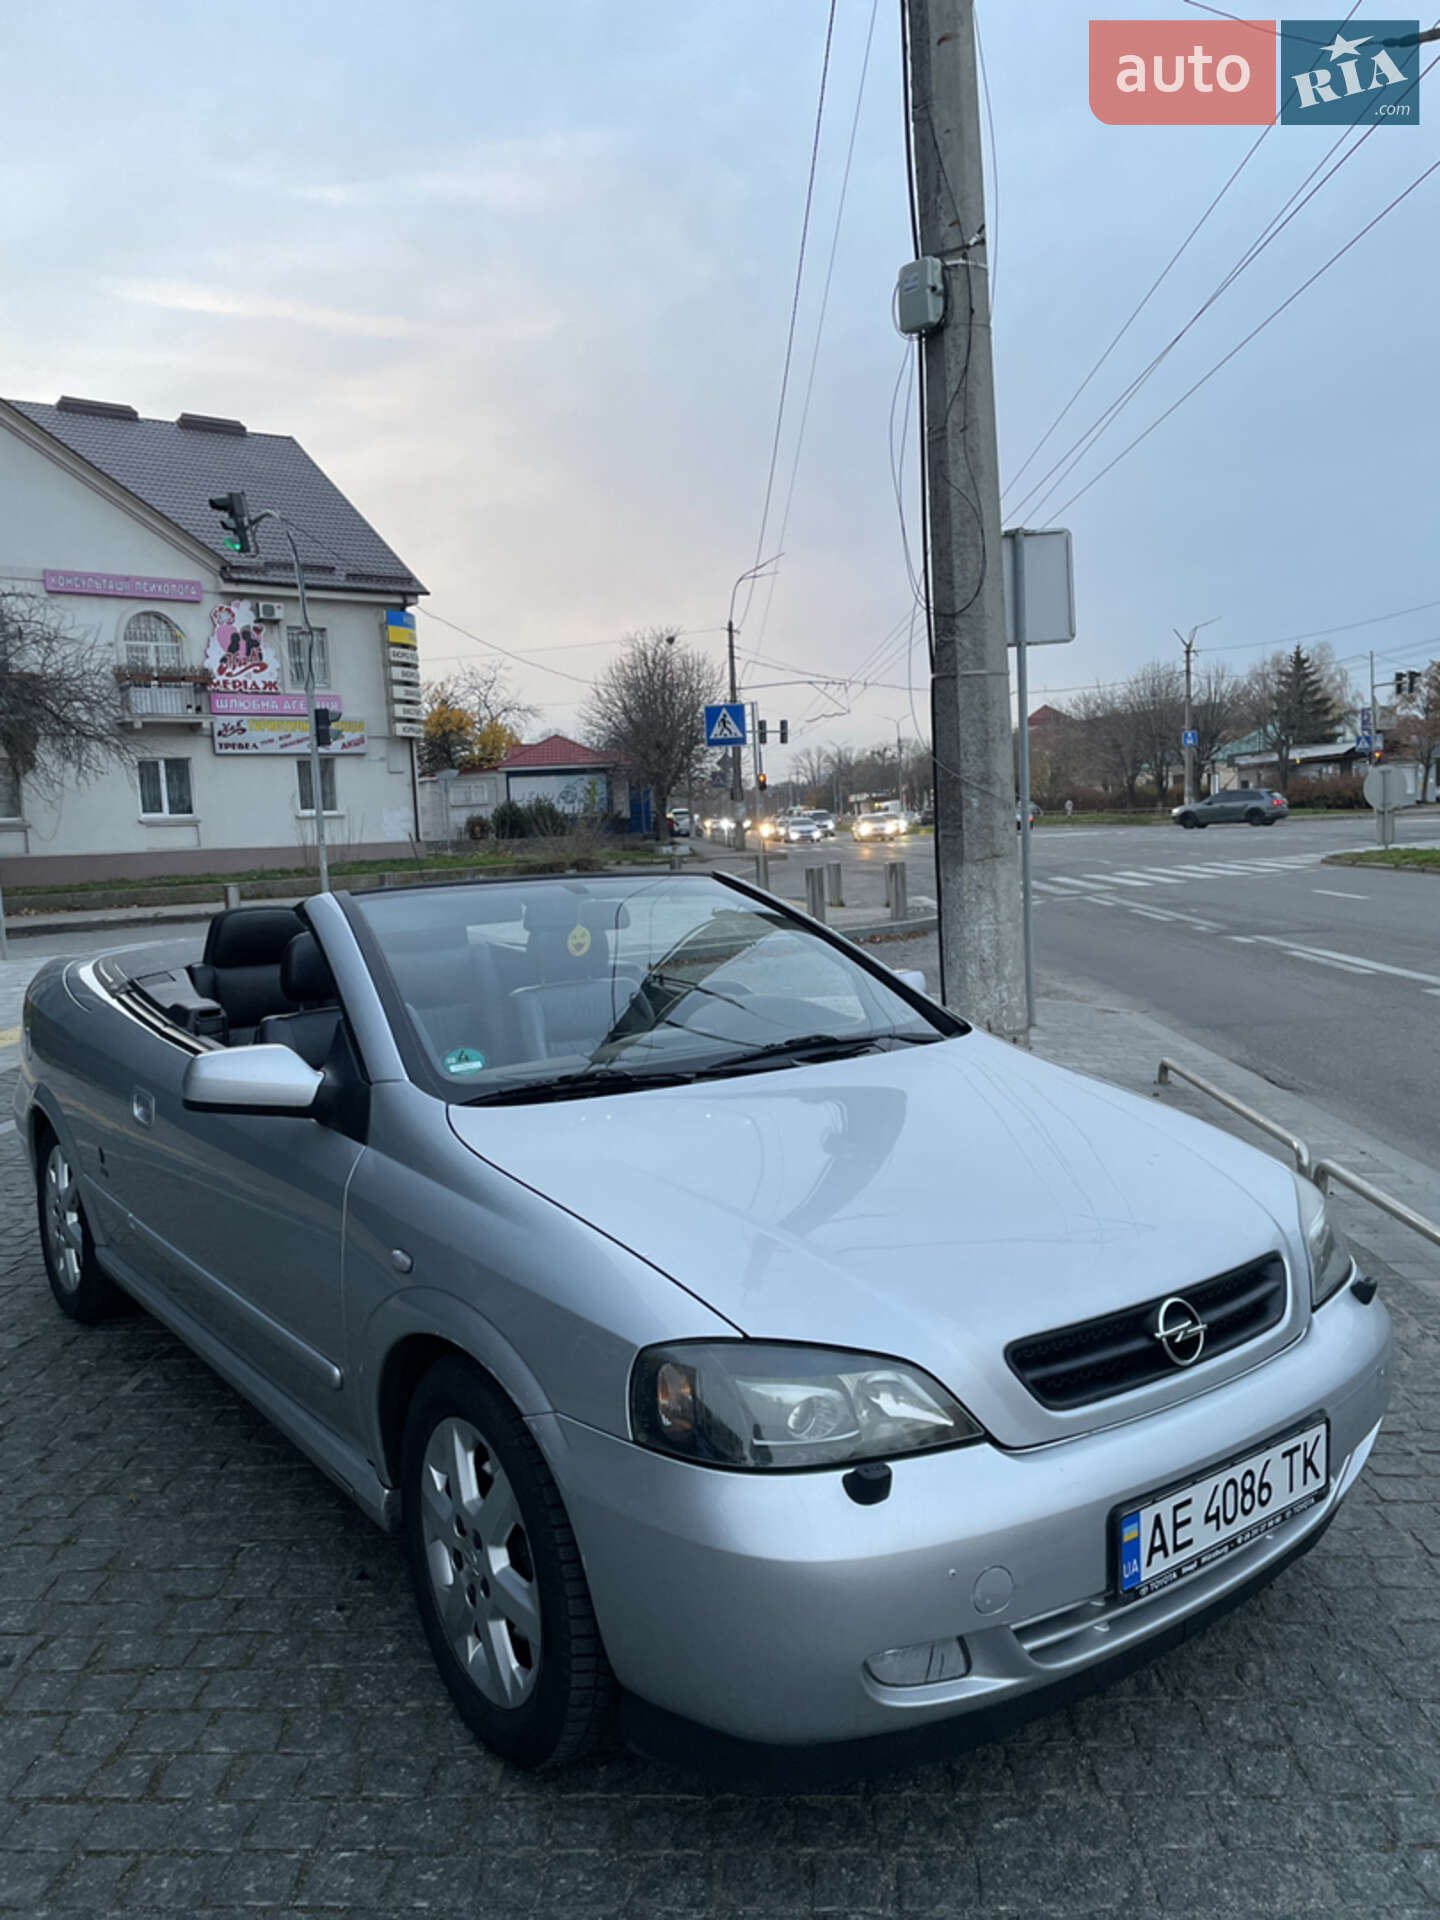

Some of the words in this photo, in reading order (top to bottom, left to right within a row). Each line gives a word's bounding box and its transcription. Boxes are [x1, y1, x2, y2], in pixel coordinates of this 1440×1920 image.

[216, 700, 279, 710] ШЛЮБНА
[283, 700, 339, 711] АГЕЦІЯ
[1146, 1497, 1193, 1567] AE
[1204, 1459, 1272, 1532] 4086
[1281, 1434, 1321, 1493] TK
[1122, 1559, 1139, 1578] UA
